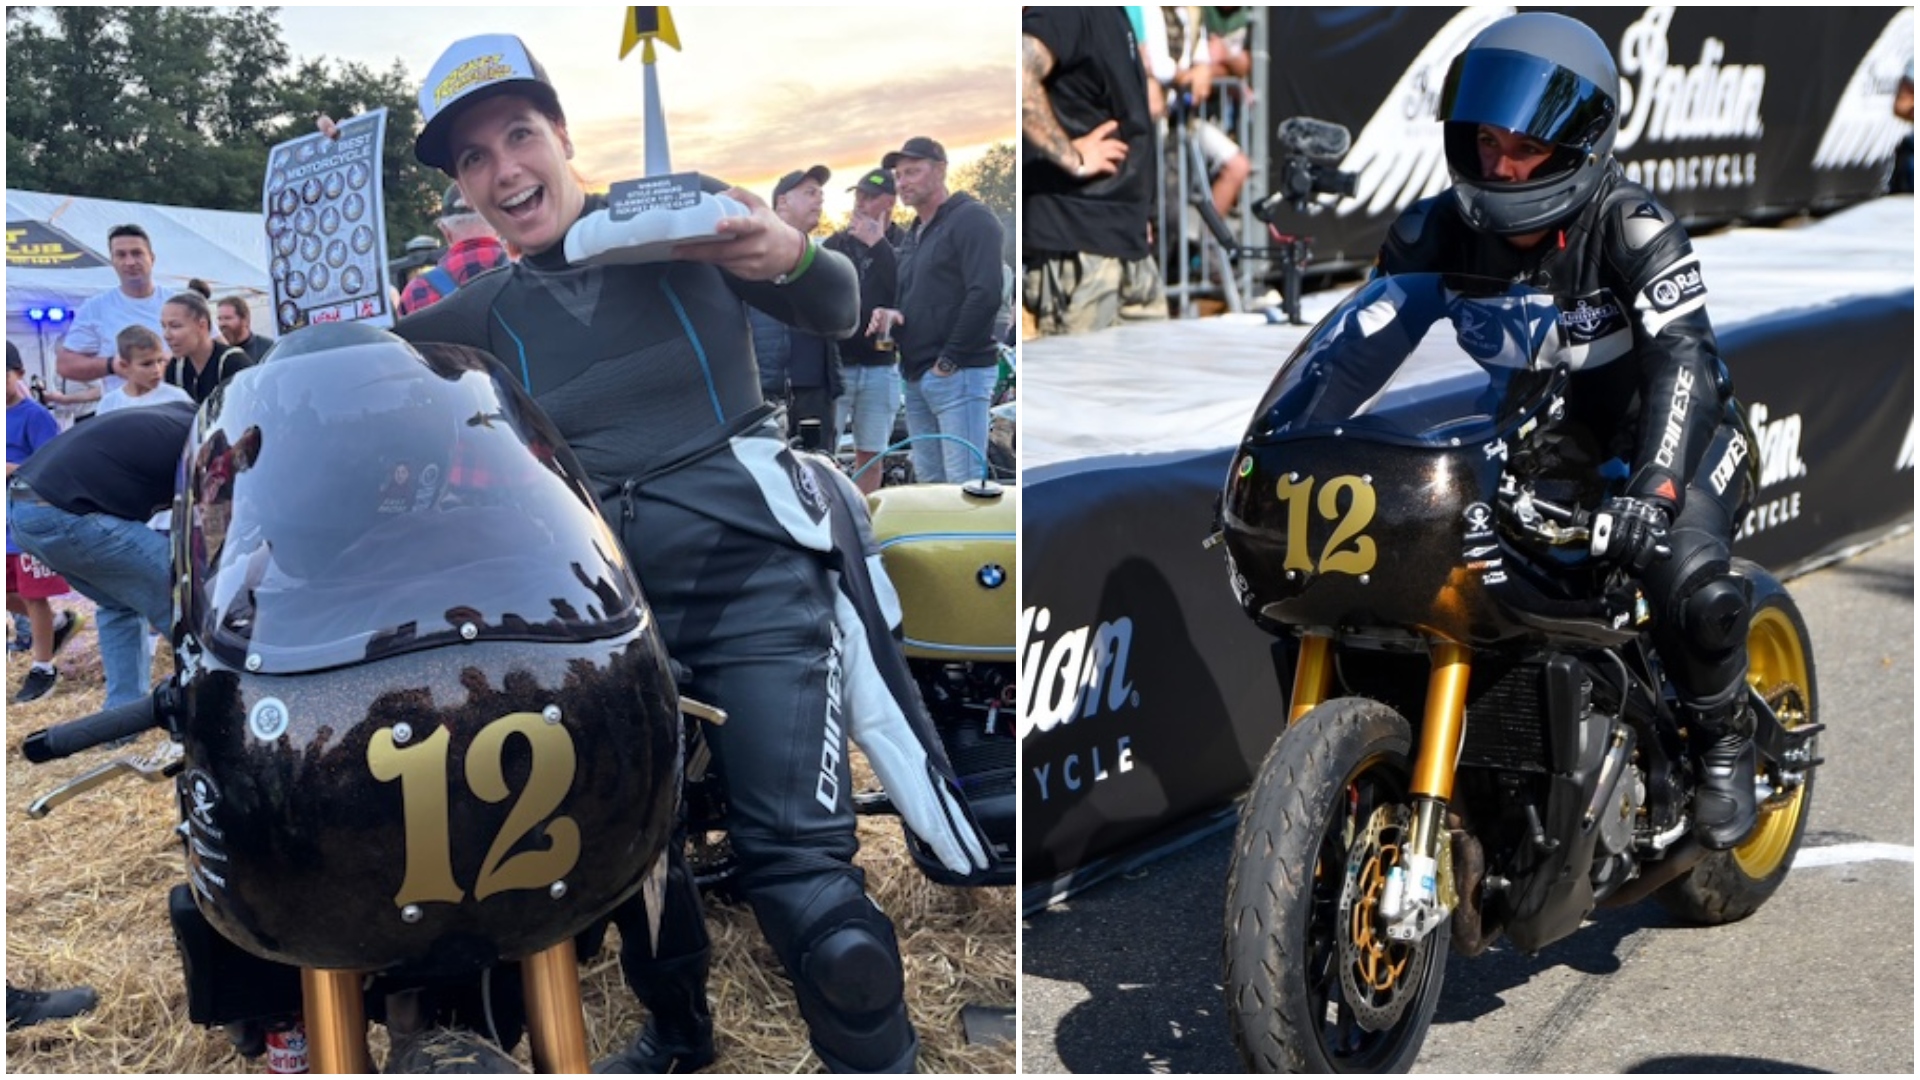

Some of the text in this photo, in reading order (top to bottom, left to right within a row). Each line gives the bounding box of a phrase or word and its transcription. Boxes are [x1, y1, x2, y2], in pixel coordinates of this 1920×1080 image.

[285, 144, 372, 178] MOTORCYCLE
[338, 132, 373, 153] BEST
[1619, 153, 1756, 192] OTORCYCLE
[1654, 366, 1696, 469] DAINESE
[1276, 472, 1378, 575] 12
[366, 712, 582, 908] 12
